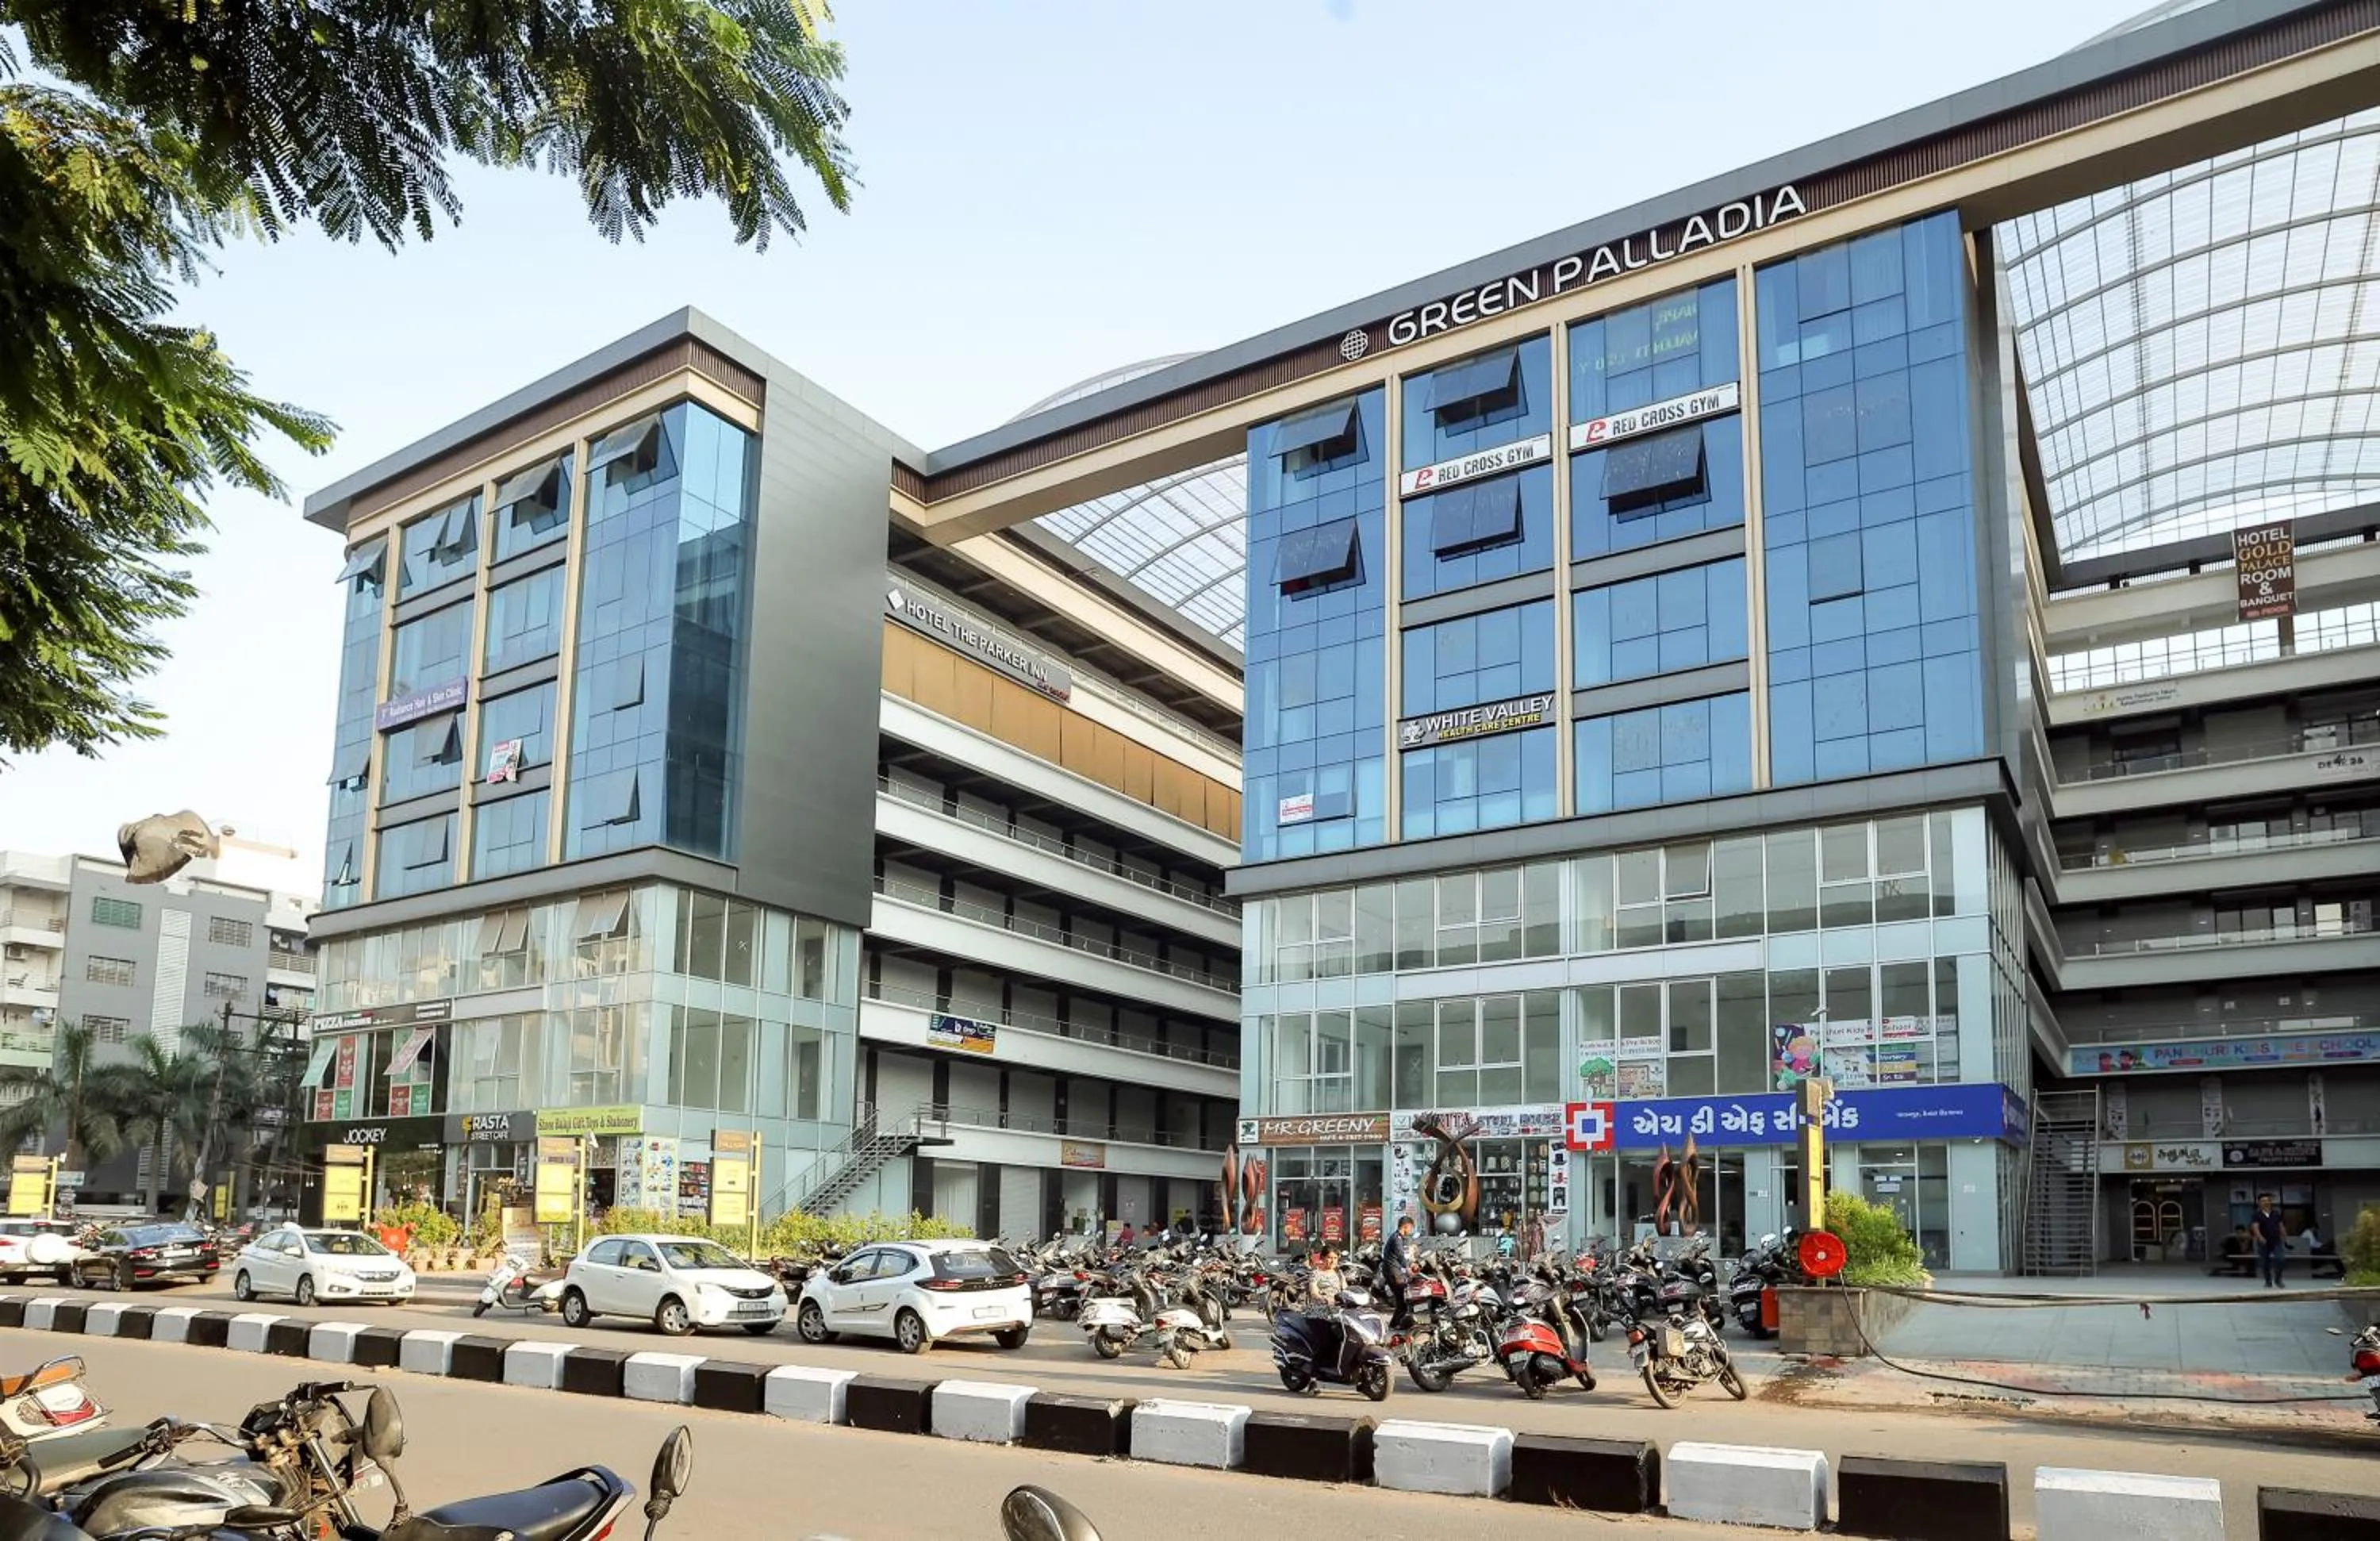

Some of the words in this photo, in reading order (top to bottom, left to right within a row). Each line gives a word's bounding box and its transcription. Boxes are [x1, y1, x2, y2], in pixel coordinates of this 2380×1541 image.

[1388, 269, 1538, 345] GREEN
[1553, 184, 1807, 294] PALLADIA
[1613, 416, 1637, 435] RED
[1641, 402, 1685, 428] CROSS
[1690, 394, 1720, 414] GYM
[1438, 465, 1461, 482] RED
[1464, 452, 1503, 475] CROSS
[1507, 444, 1534, 463] GYM
[2237, 527, 2290, 547] HOTEL
[2238, 540, 2291, 561] GOLD
[2240, 555, 2291, 572] PALACE
[2240, 566, 2292, 585] ROOM
[2259, 581, 2274, 595] &
[2240, 591, 2294, 608] BANQUET
[904, 598, 950, 634] HOTEL
[952, 622, 977, 646] THE
[977, 636, 1028, 674] PARKER
[1028, 661, 1048, 682] INN
[1425, 708, 1483, 732] WHITE
[1484, 695, 1554, 720] VALLEY
[1437, 726, 1473, 740] HEALTH
[1476, 721, 1499, 733] CARE
[1503, 713, 1541, 728] CENTRE
[472, 1115, 509, 1131] RASTA
[1633, 1108, 1682, 1136] એચ
[1690, 1105, 1714, 1135] ડી
[1721, 1104, 1765, 1136] એફ
[344, 1128, 387, 1143] JOCKEY
[470, 1132, 493, 1141] STREET
